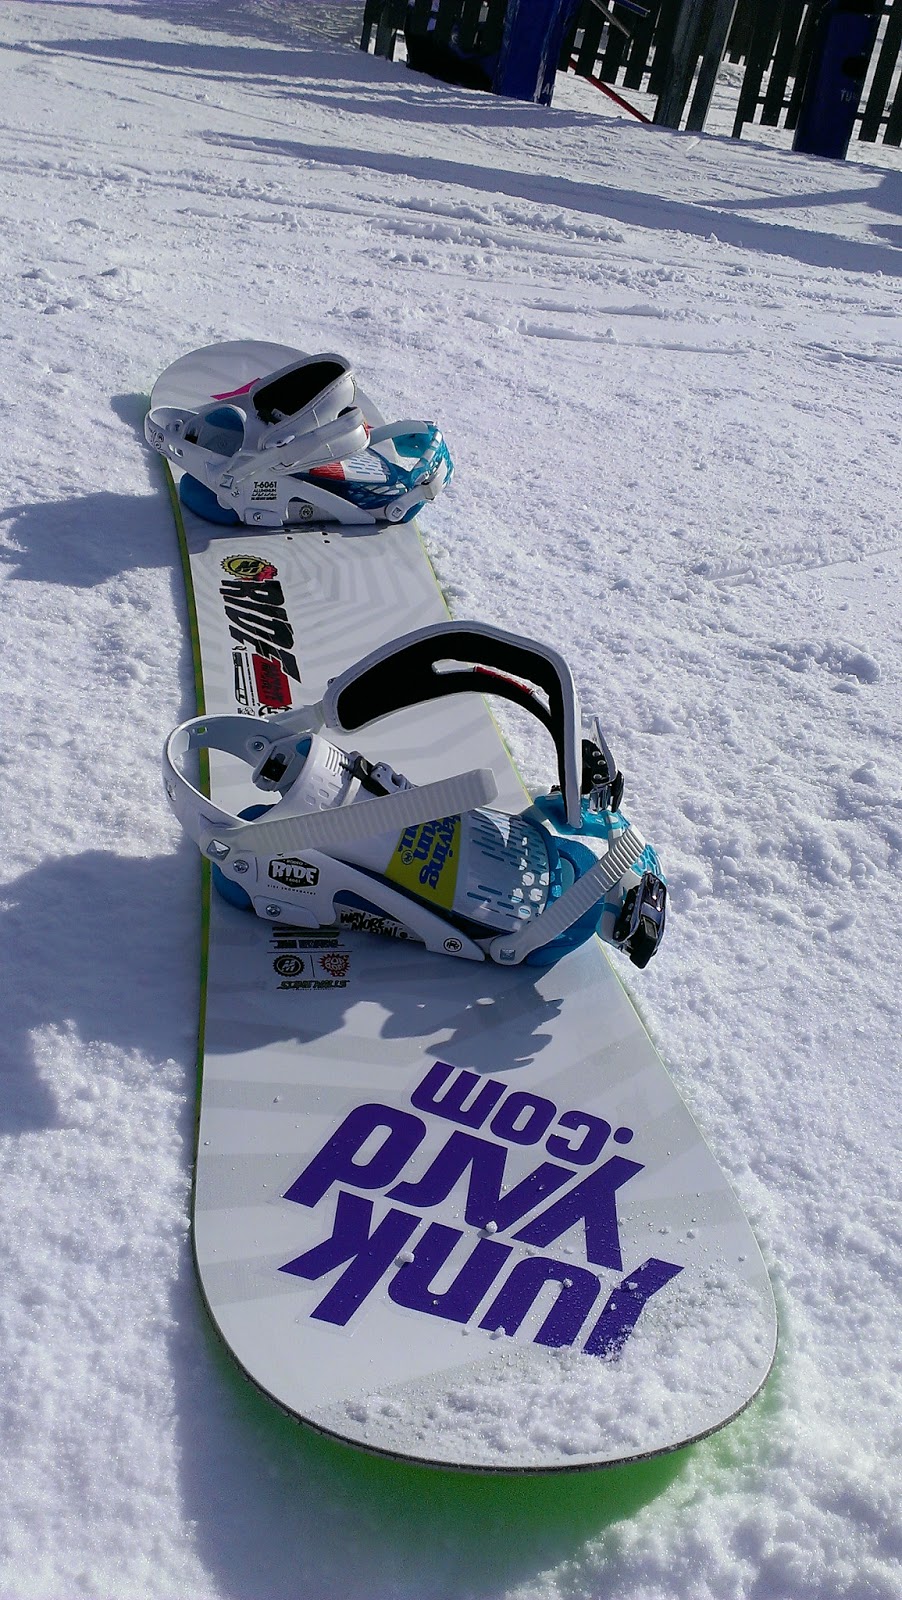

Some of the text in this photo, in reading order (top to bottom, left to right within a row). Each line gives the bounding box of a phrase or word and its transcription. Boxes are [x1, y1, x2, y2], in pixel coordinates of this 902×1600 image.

[253, 481, 278, 489] T-6061
[219, 579, 301, 683] RIDE
[271, 860, 317, 885] RIDE
[411, 1061, 634, 1166] .com
